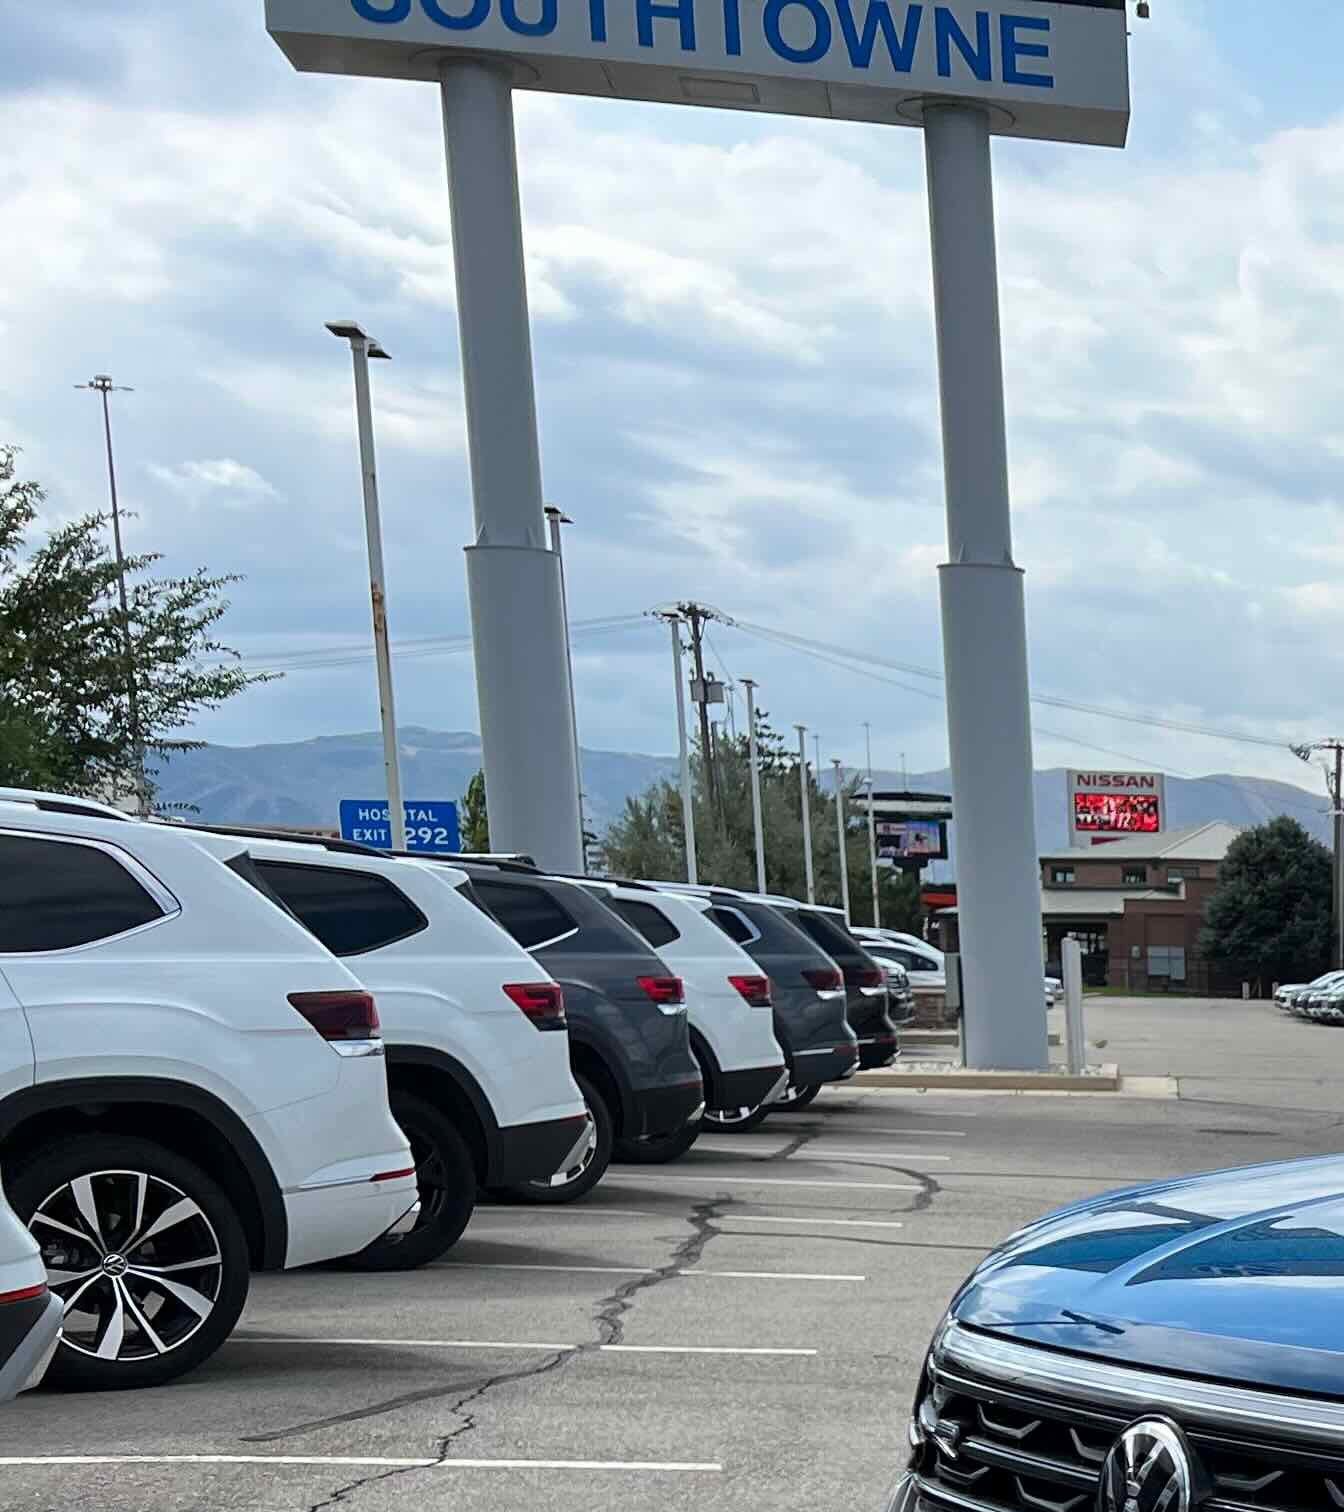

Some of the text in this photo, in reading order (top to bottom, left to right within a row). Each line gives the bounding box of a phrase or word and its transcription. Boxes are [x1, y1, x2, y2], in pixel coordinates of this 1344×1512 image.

[1076, 774, 1155, 788] NISSAN
[358, 808, 438, 821] HOSTAL
[352, 827, 449, 845] EXIT 292
